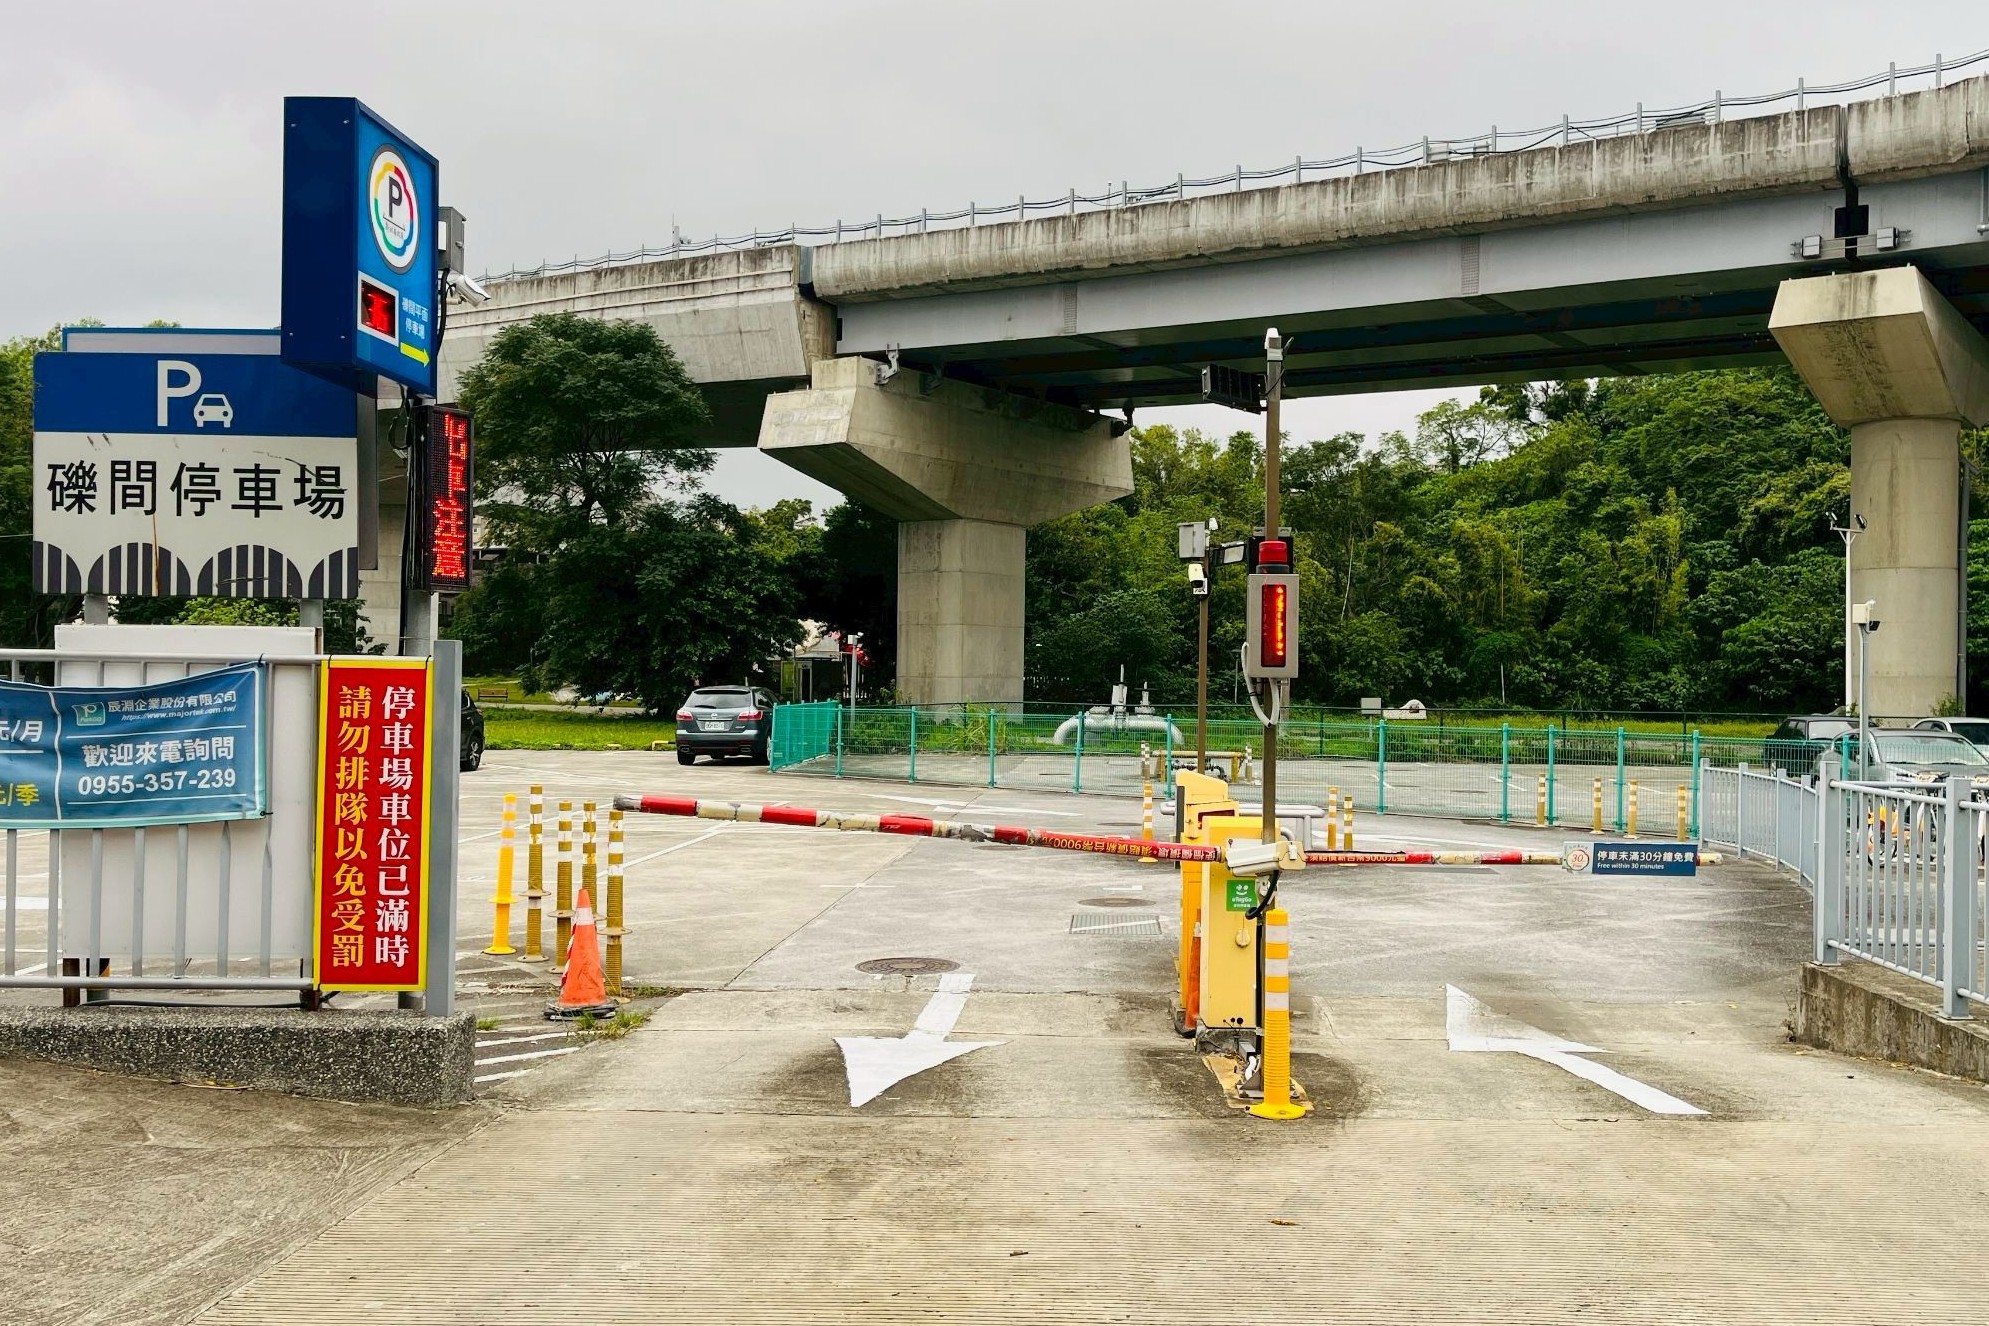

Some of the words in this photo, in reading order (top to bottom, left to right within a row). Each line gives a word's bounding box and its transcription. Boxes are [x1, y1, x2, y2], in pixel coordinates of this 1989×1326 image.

[389, 176, 403, 218] P
[157, 360, 202, 427] P
[46, 460, 346, 520] 礫間停車場
[107, 690, 237, 713] 辰淵企業股份有限公司
[82, 736, 235, 768] 歡迎來電詢問
[78, 768, 236, 796] 0955-357-239
[331, 685, 373, 968] 請勿排隊以免受罰
[375, 686, 416, 968] 停車場車位已滿時
[1597, 850, 1694, 863] 停車未滿30分鐘免費
